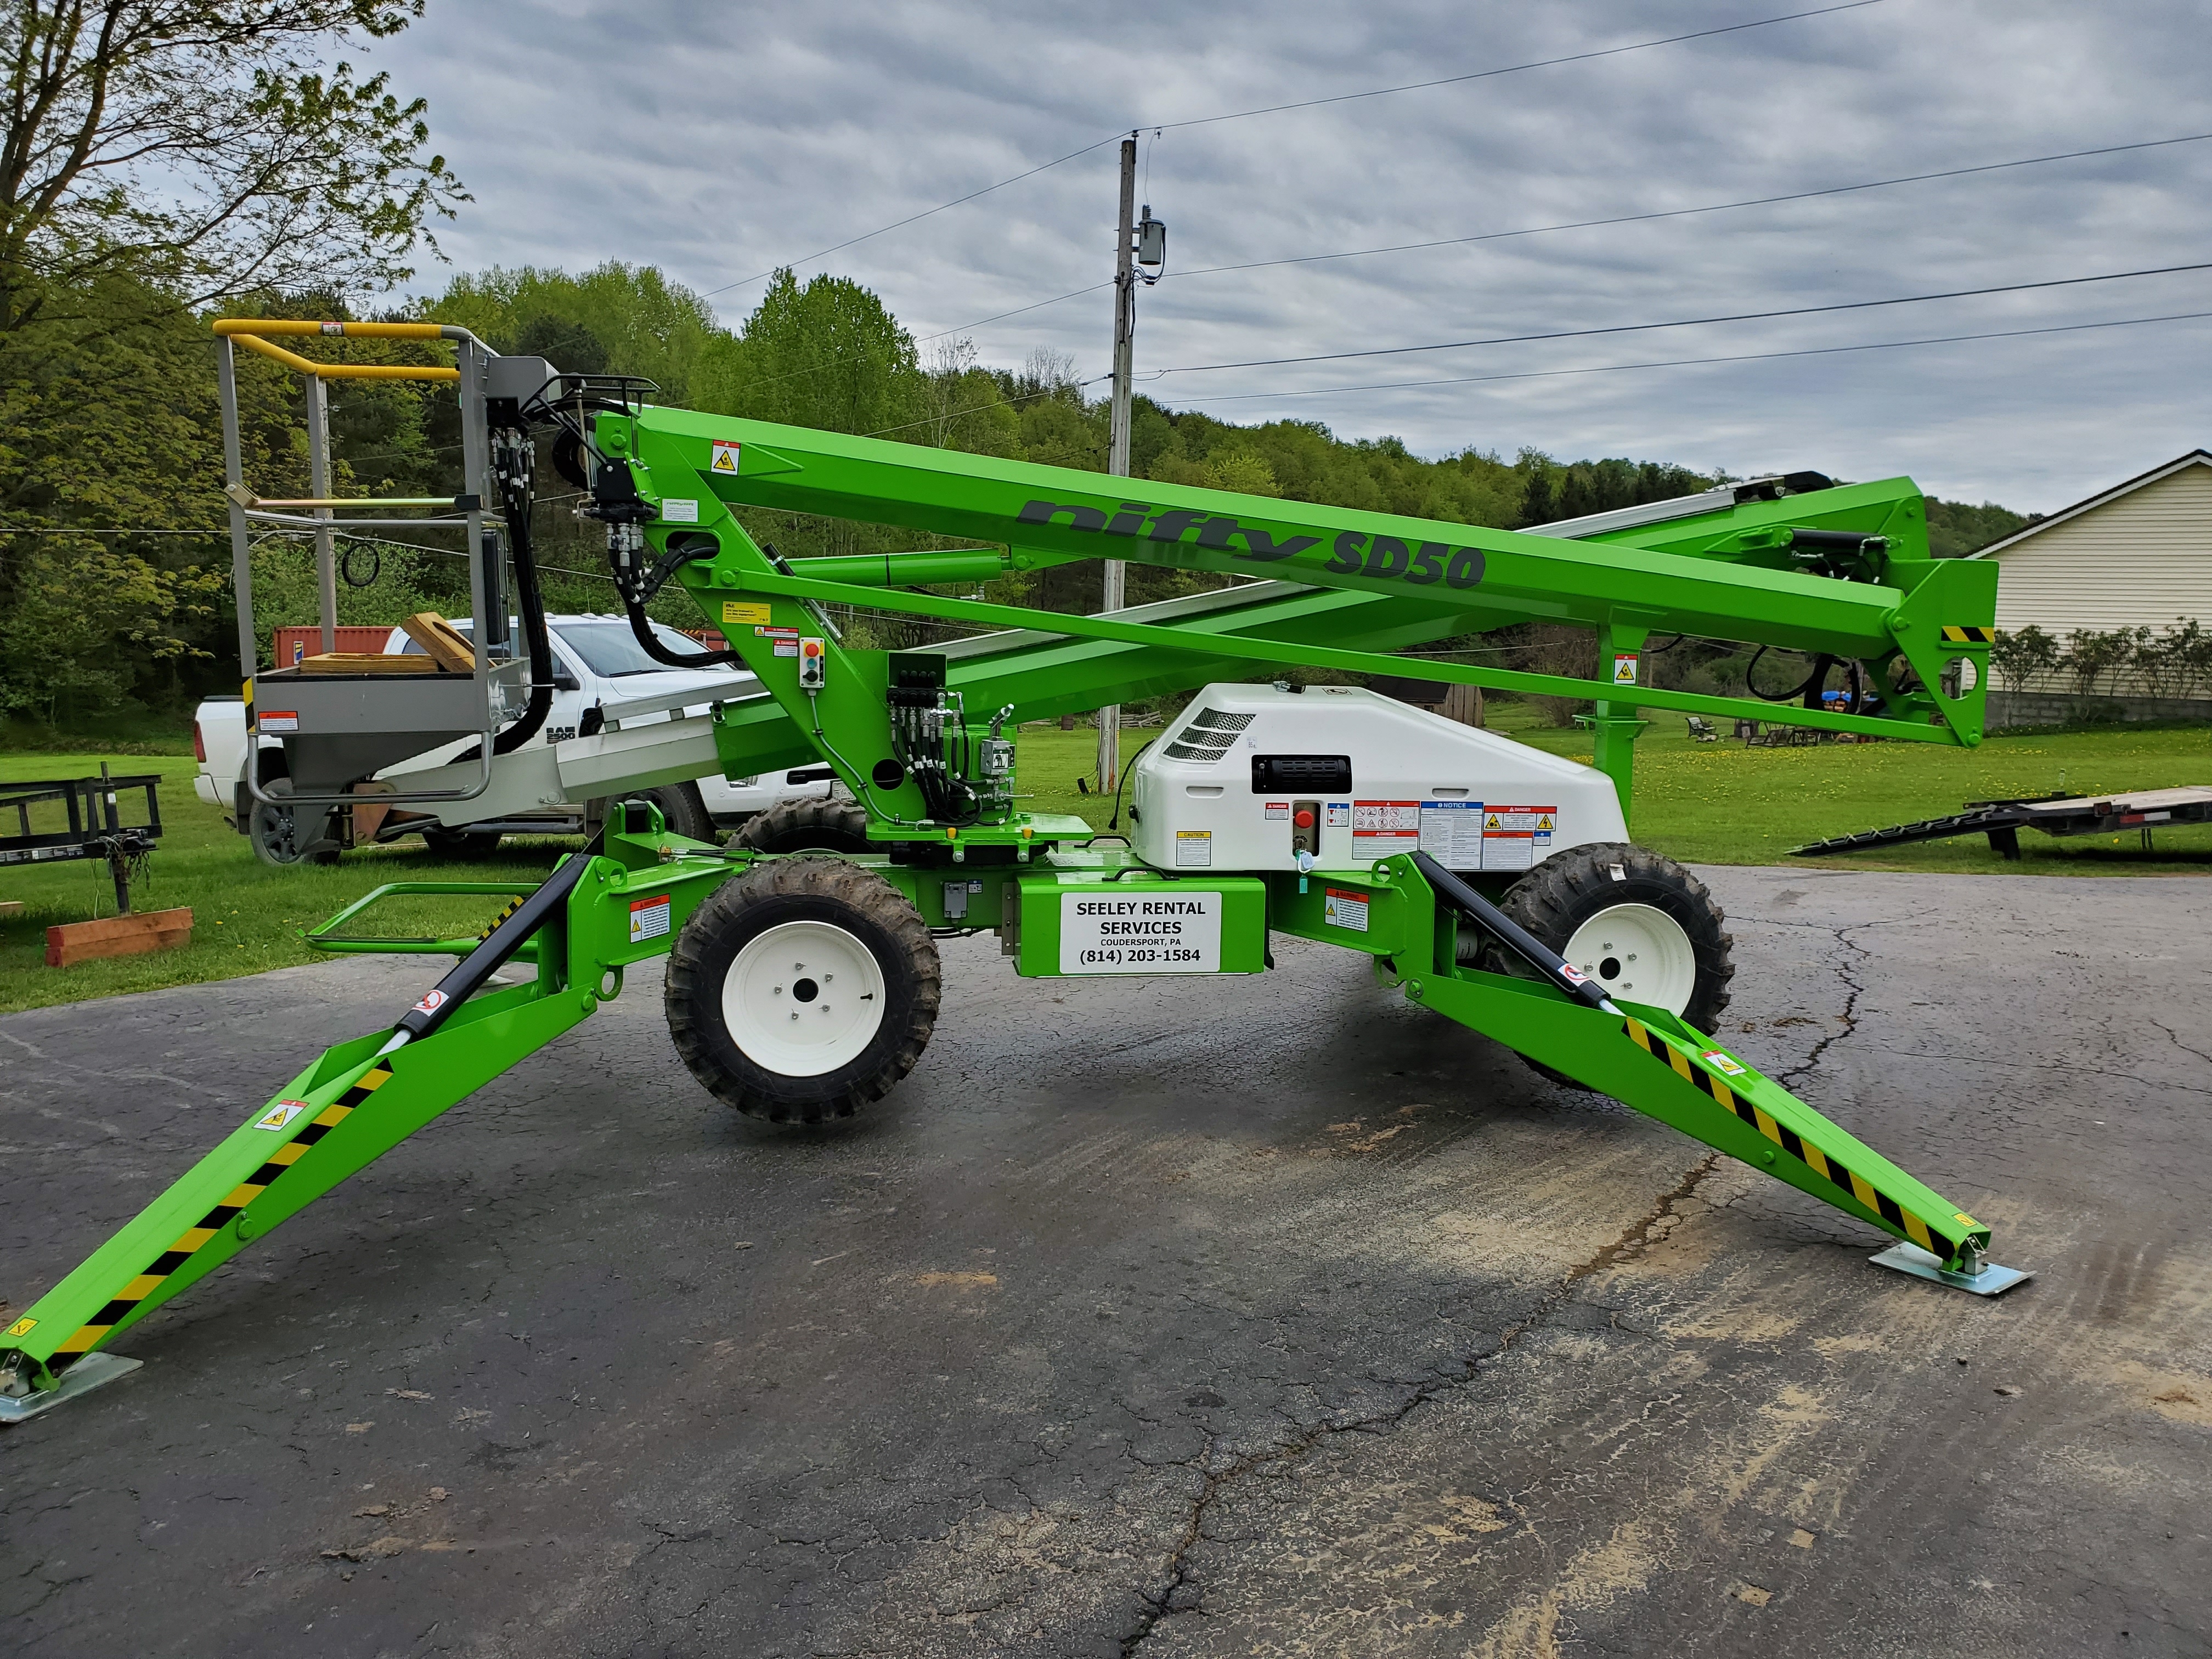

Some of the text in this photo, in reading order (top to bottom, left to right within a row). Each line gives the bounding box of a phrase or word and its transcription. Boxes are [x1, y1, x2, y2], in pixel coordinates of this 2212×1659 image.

[1016, 500, 1487, 589] nifty SD50
[1076, 902, 1206, 915] SEELEY RENTAL
[1100, 922, 1182, 935] SERVICES
[1101, 938, 1167, 947] COUDERSPORT,
[1080, 949, 1201, 965] (814) 203-1584
